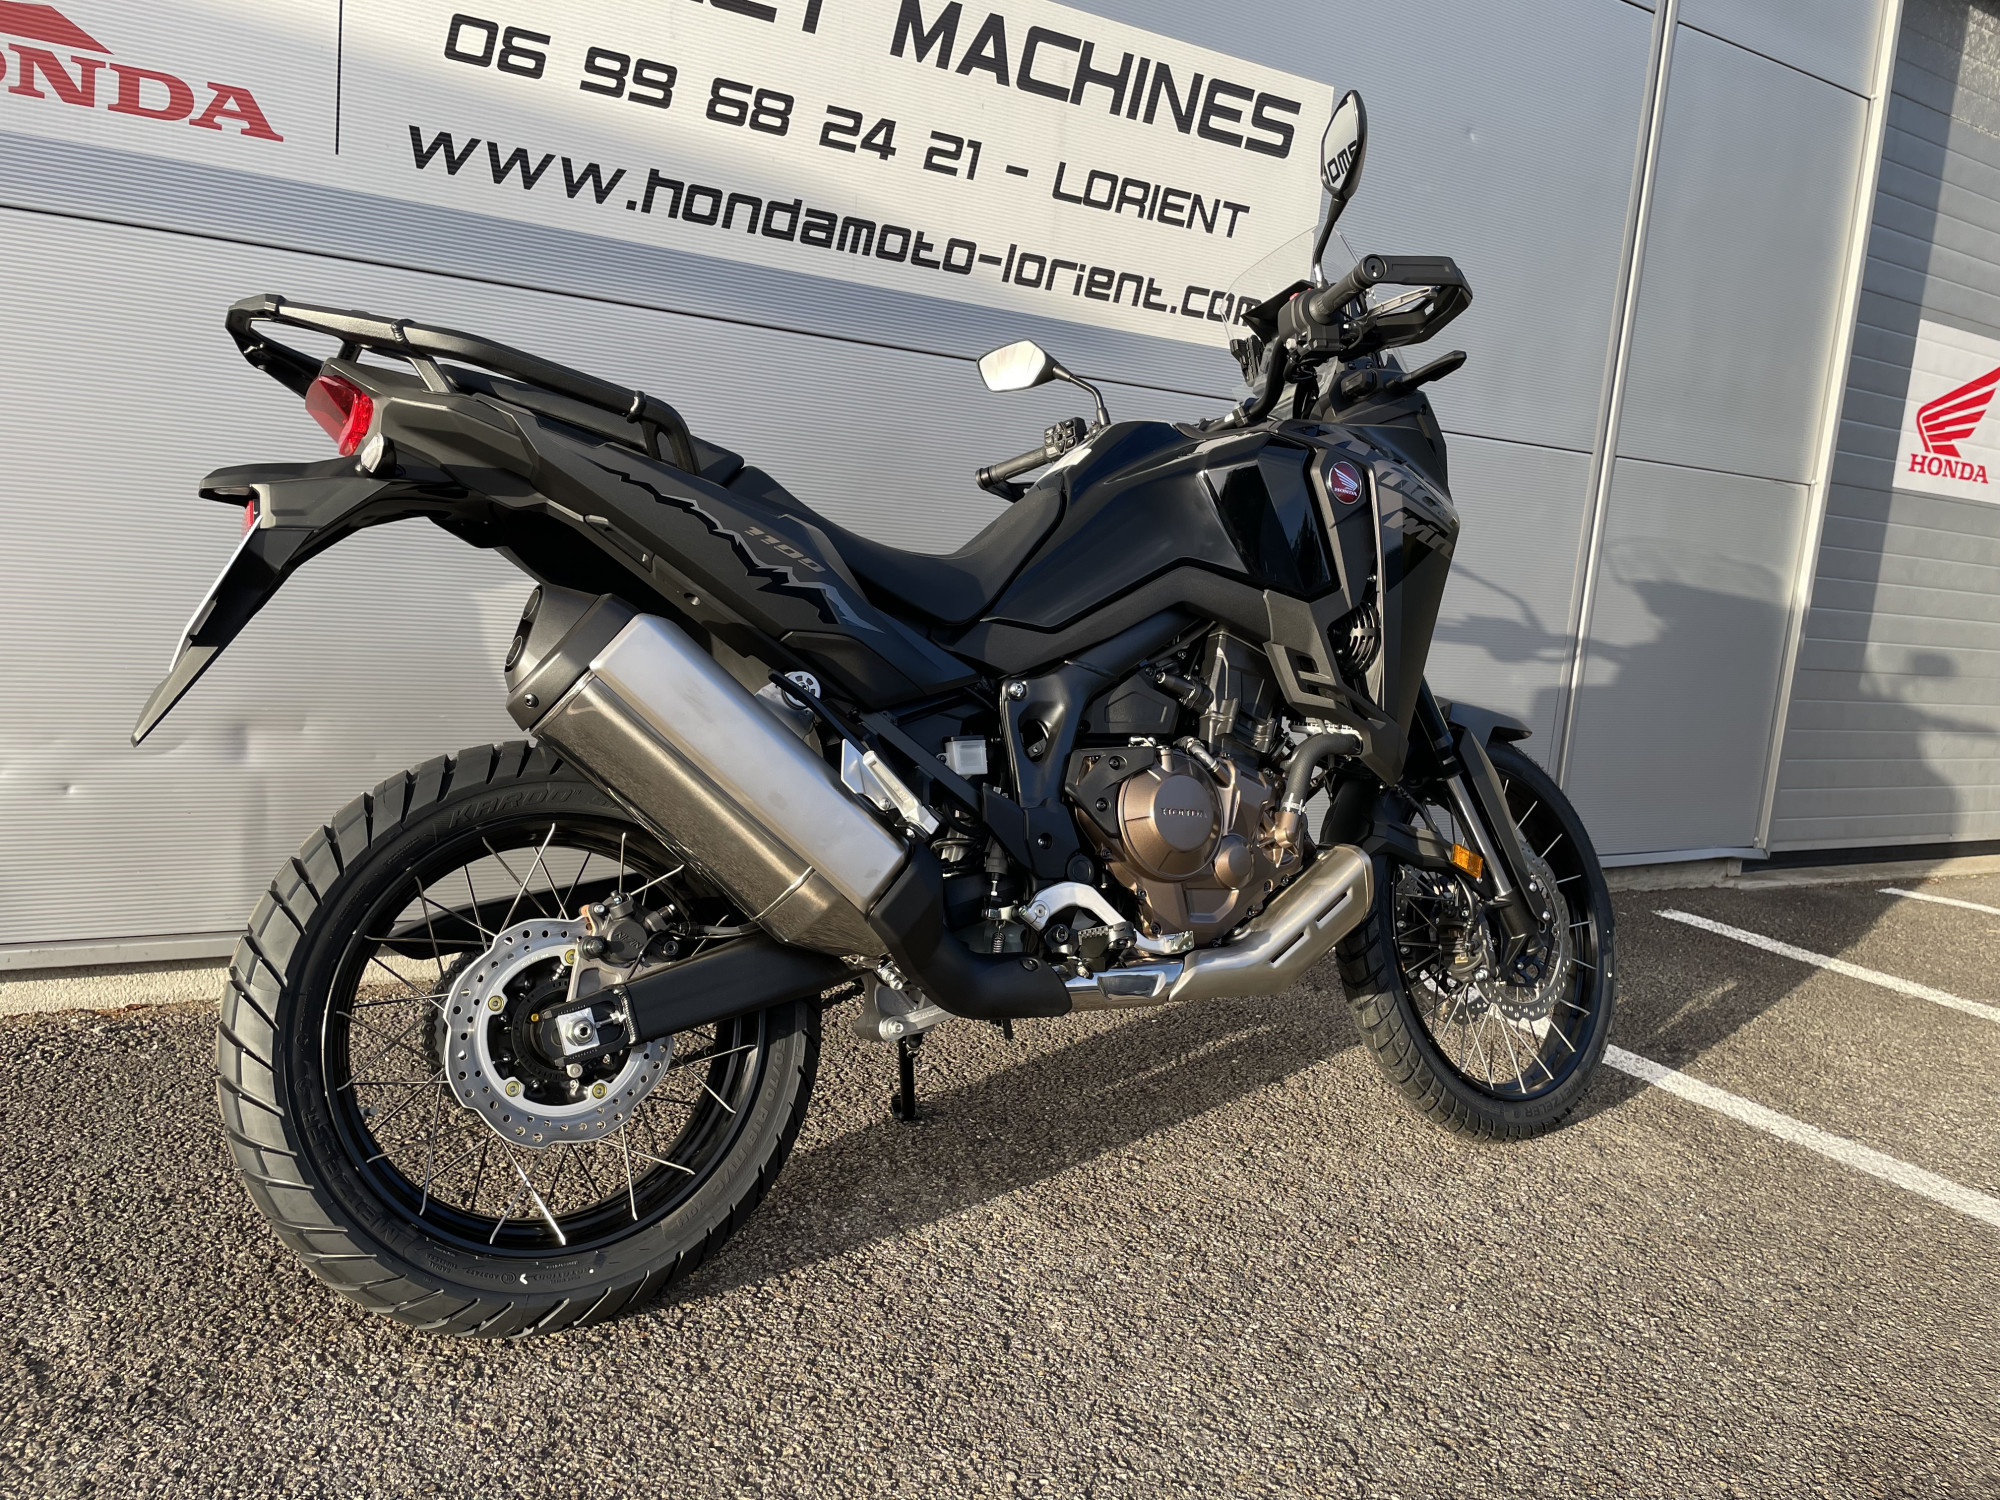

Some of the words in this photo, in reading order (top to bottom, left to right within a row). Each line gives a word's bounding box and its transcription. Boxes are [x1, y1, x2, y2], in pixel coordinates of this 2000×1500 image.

[0, 43, 284, 142] NDA
[890, 0, 1302, 159] MACHINES
[444, 13, 551, 79] 06
[580, 46, 678, 109] 99
[706, 77, 795, 136] 68
[819, 105, 897, 160] 24
[922, 130, 983, 180] 21
[1053, 161, 1250, 238] LORIENT
[1334, 486, 1358, 497] HONDA
[1908, 453, 1989, 484] HONDA
[744, 526, 826, 572] 1100
[1160, 807, 1208, 819] HONDA
